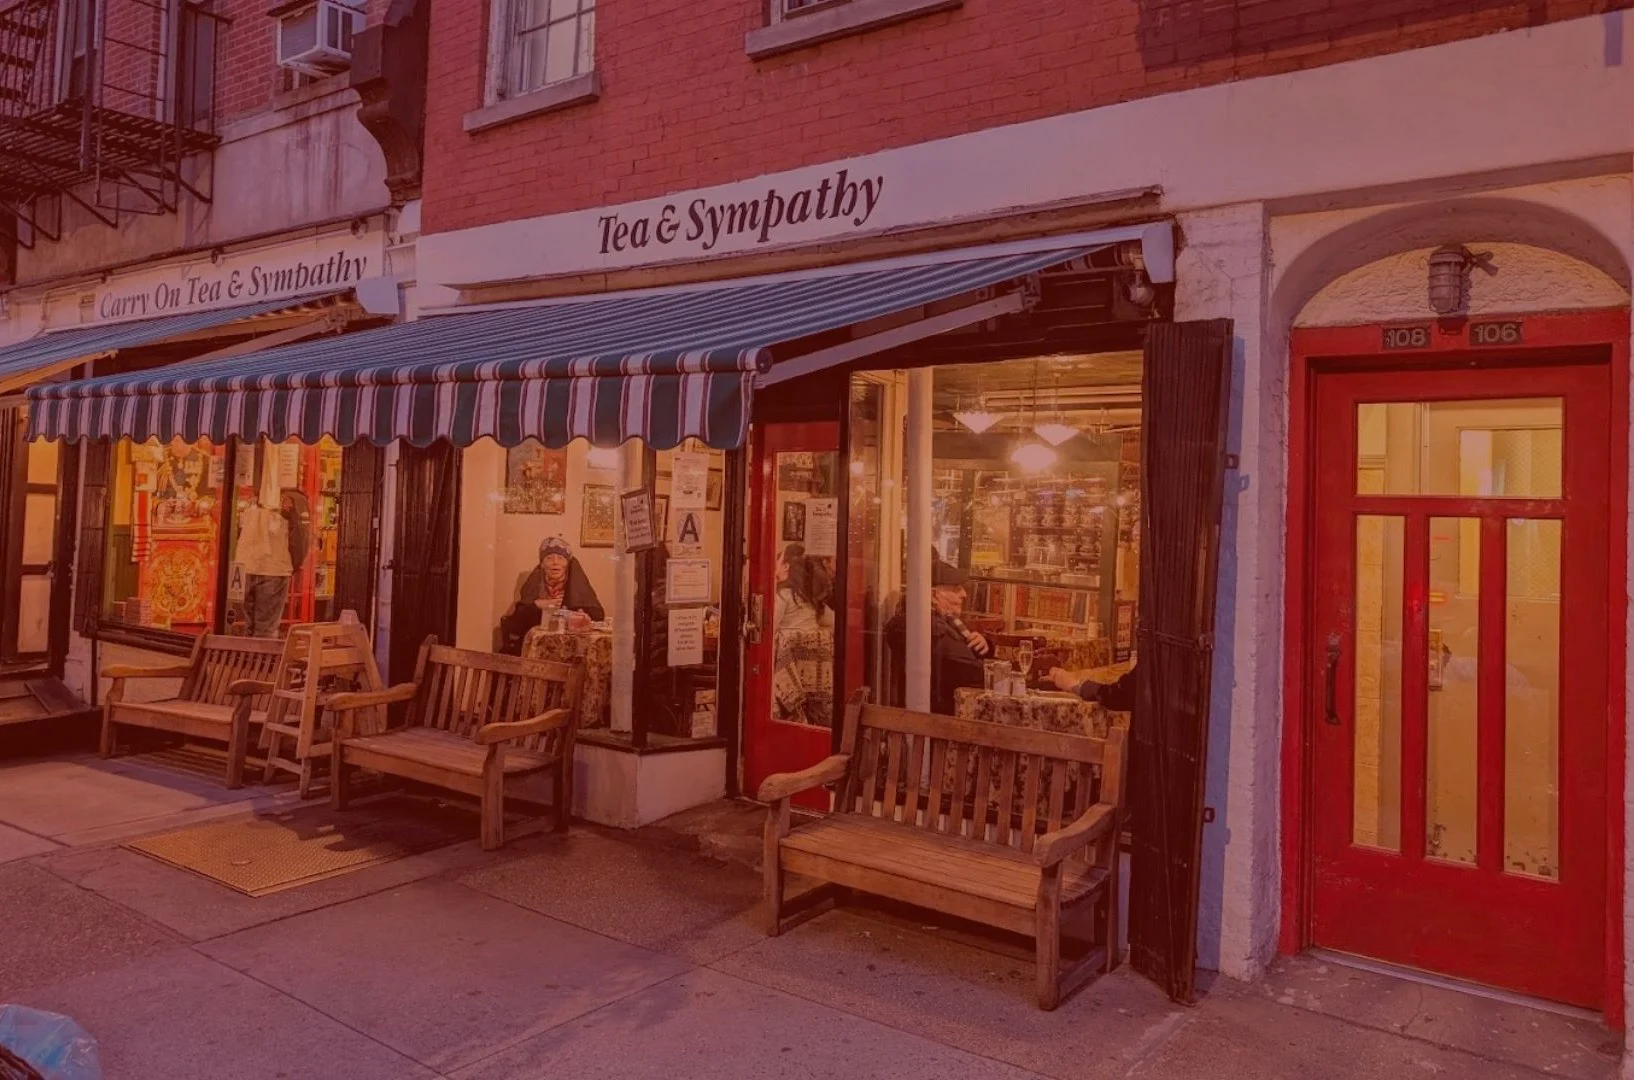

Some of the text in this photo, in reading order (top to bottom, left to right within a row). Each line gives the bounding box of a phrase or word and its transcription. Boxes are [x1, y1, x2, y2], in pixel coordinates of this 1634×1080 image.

[598, 168, 884, 254] Tea & Sympathy
[100, 250, 368, 319] Carry On Tea & Sympathy
[1388, 328, 1427, 347] 108
[1474, 322, 1518, 343] 106
[678, 512, 700, 543] A
[231, 567, 242, 589] A
